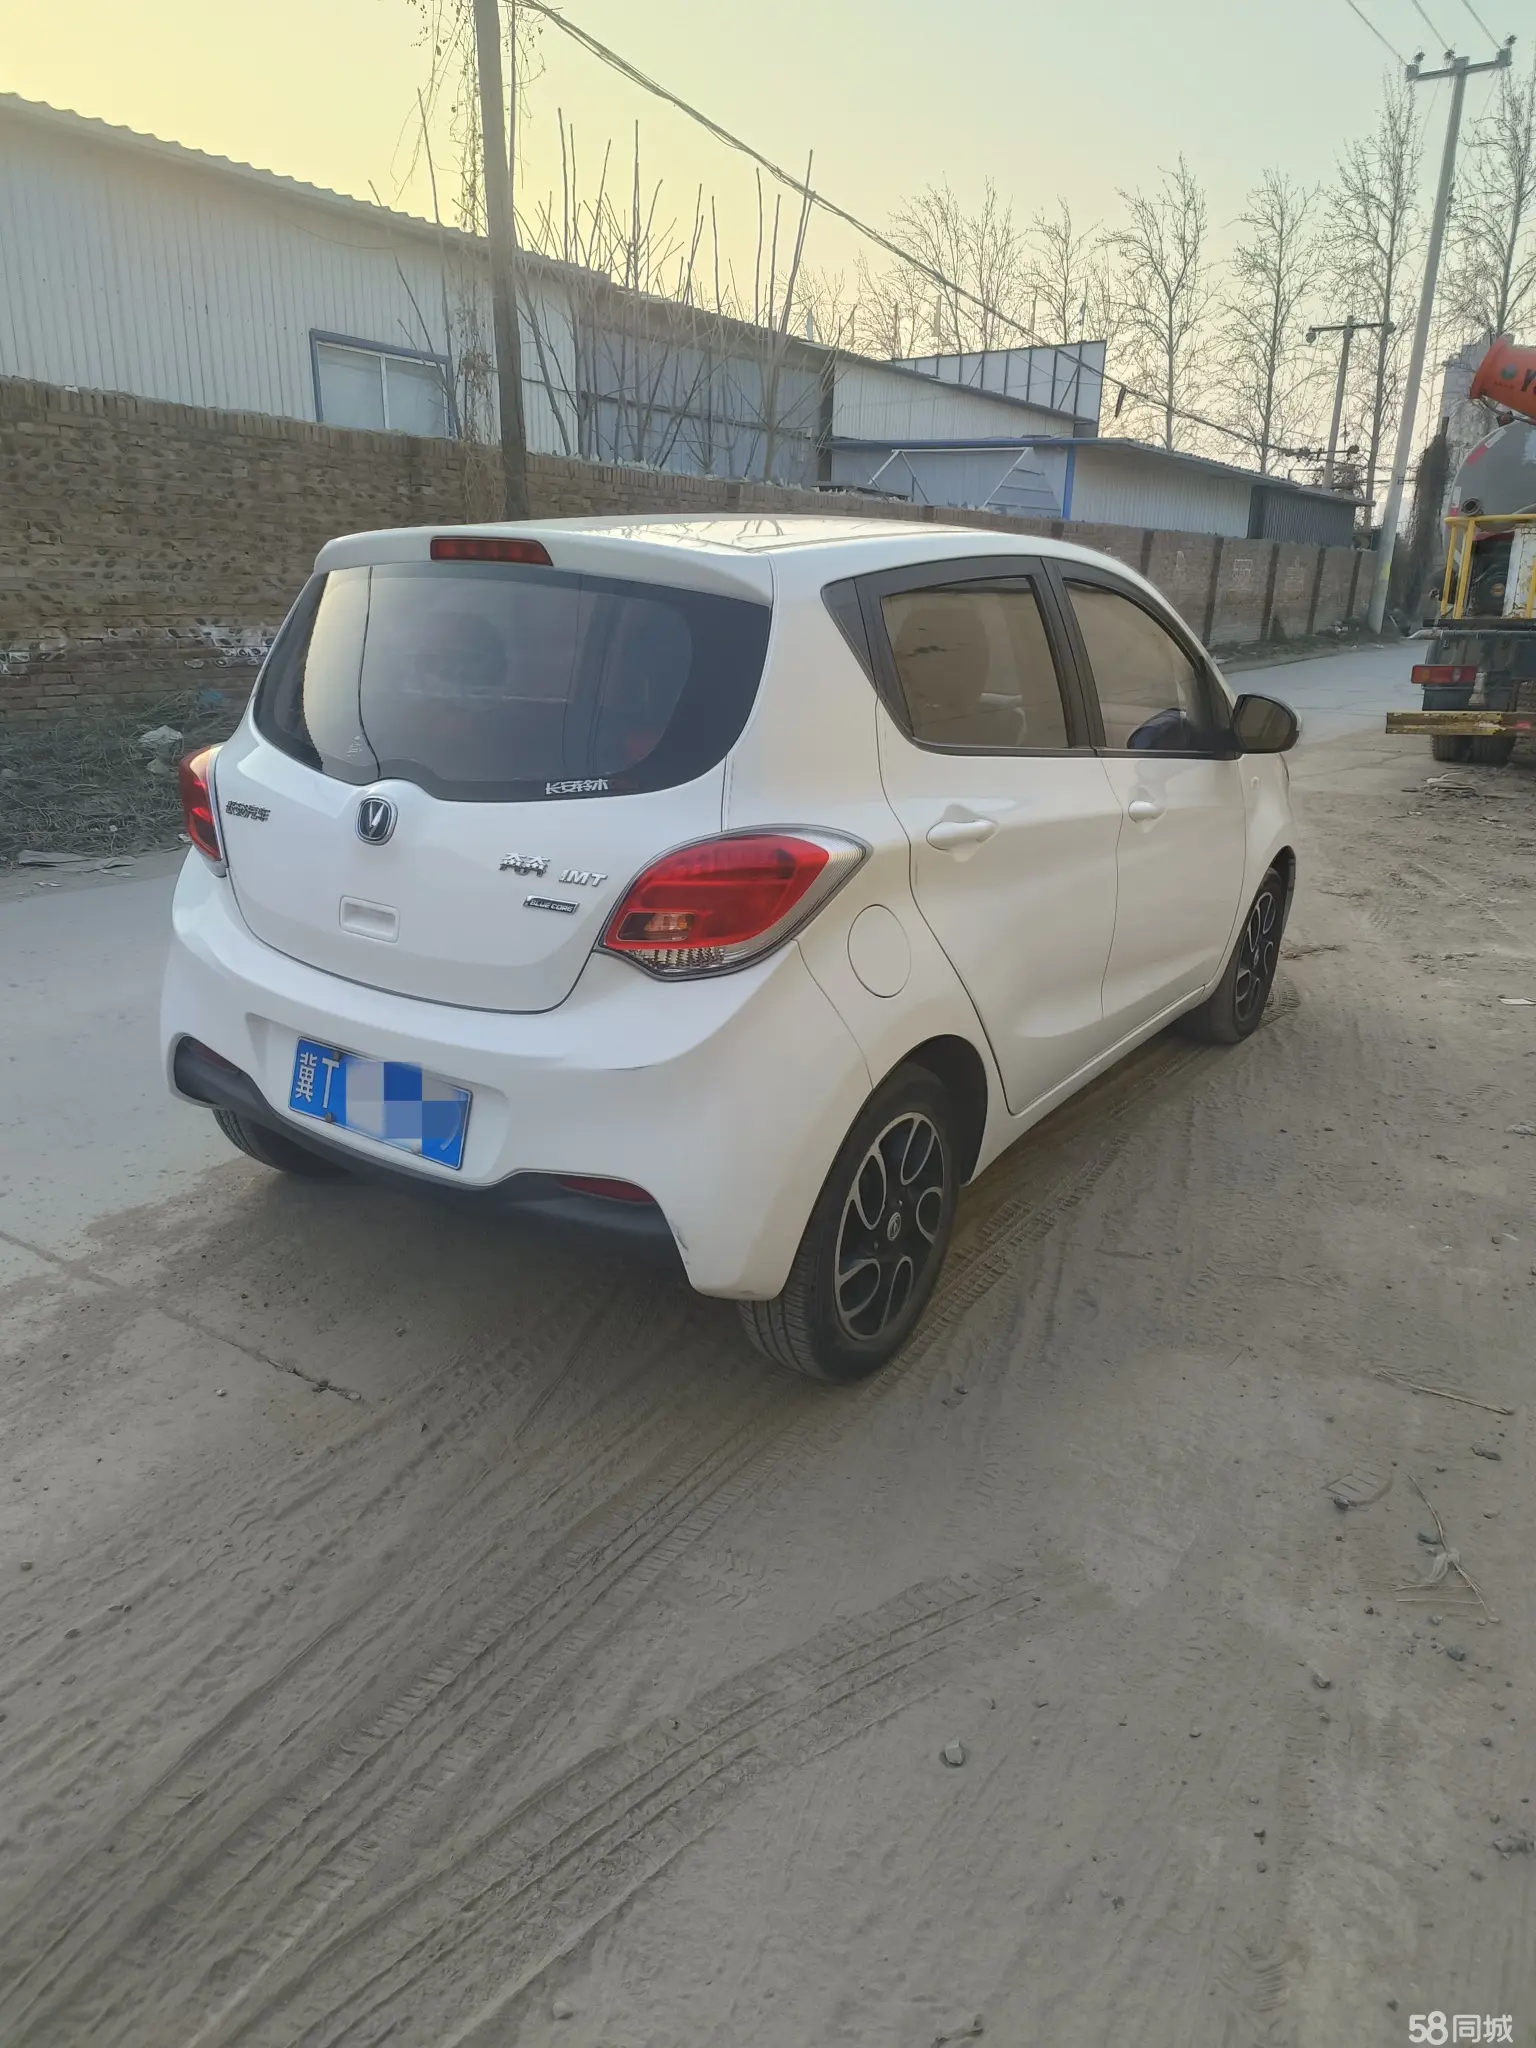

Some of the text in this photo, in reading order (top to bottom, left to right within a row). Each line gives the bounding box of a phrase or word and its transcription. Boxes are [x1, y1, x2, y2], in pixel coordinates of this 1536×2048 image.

[545, 778, 609, 795] 长安铃木
[530, 899, 550, 909] BLUE
